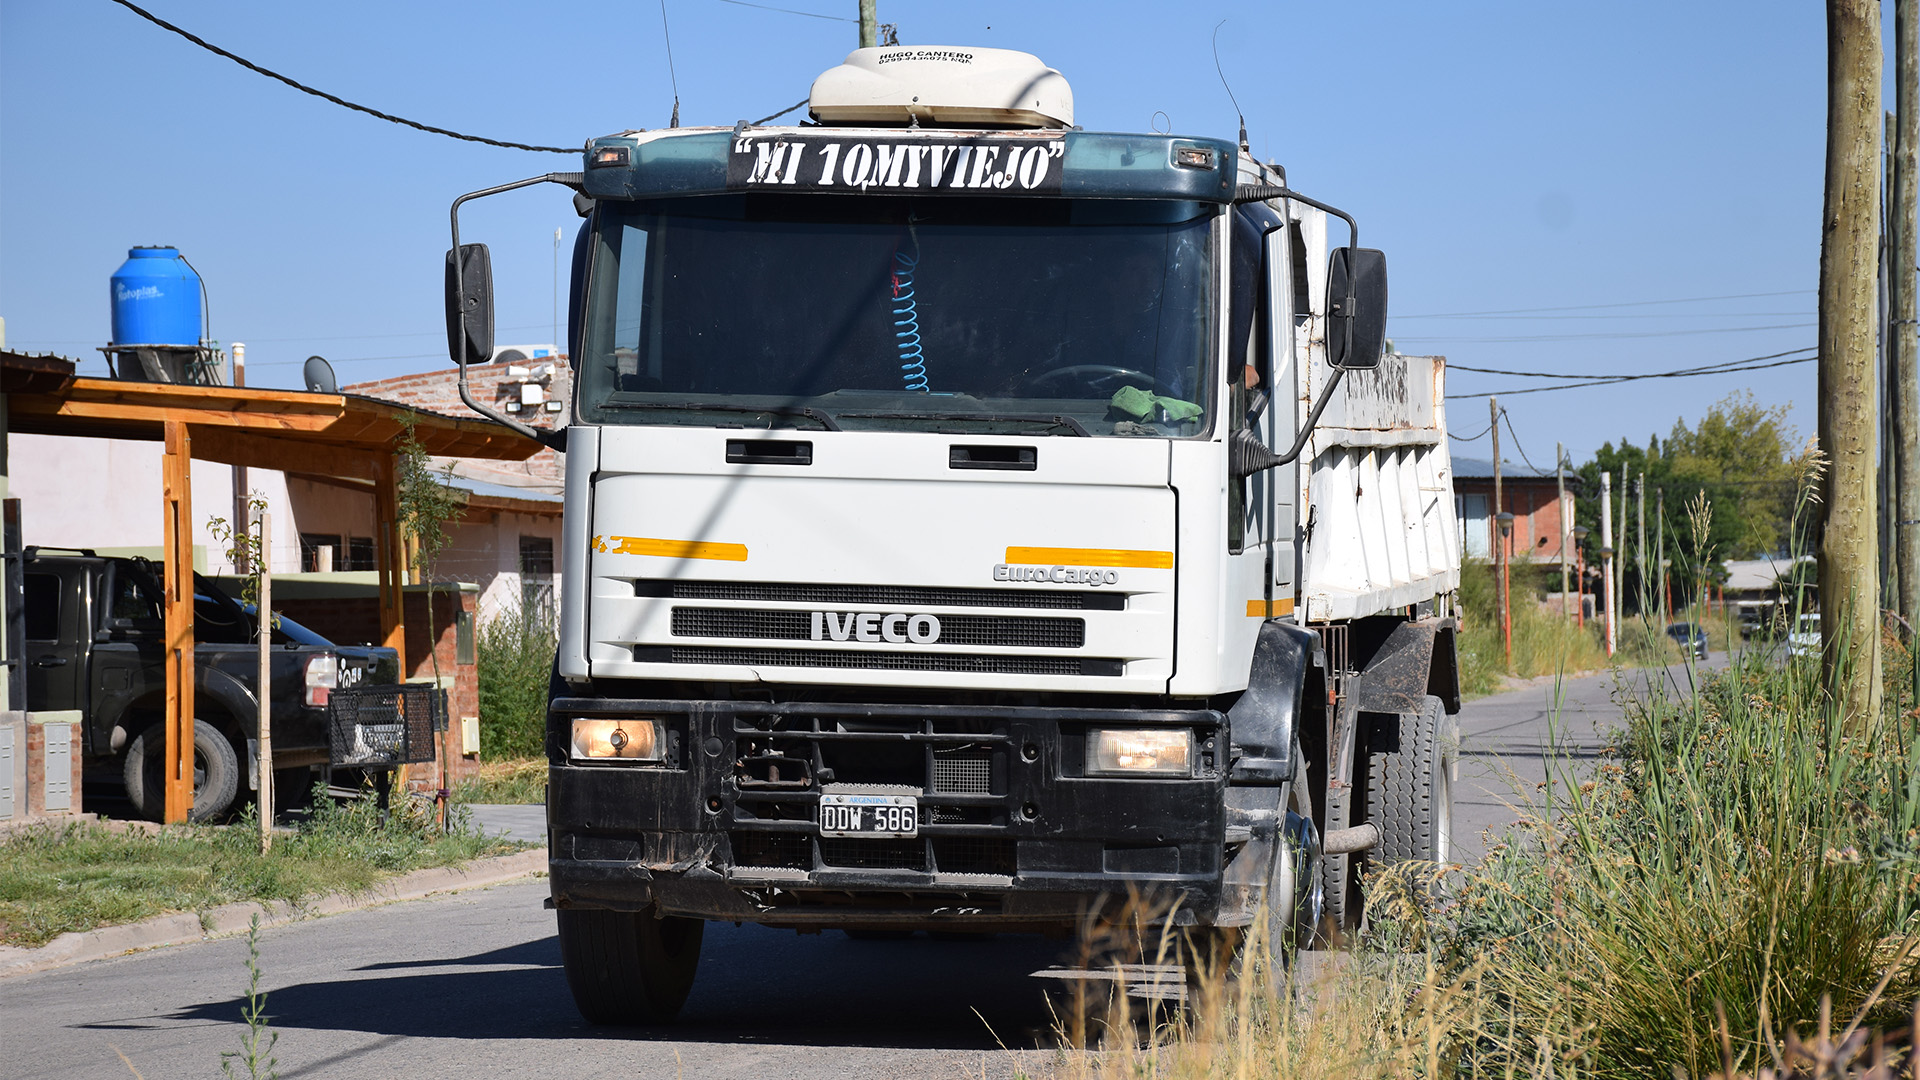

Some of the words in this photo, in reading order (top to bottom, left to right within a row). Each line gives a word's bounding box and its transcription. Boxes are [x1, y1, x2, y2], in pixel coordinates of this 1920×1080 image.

[880, 51, 913, 60] HUGO
[916, 51, 973, 60] CANTERO
[993, 564, 1120, 587] EuroCargo
[811, 612, 941, 643] IVECO
[849, 796, 888, 805] ARGENTINA
[824, 806, 861, 831] DDW
[875, 807, 913, 831] 586
